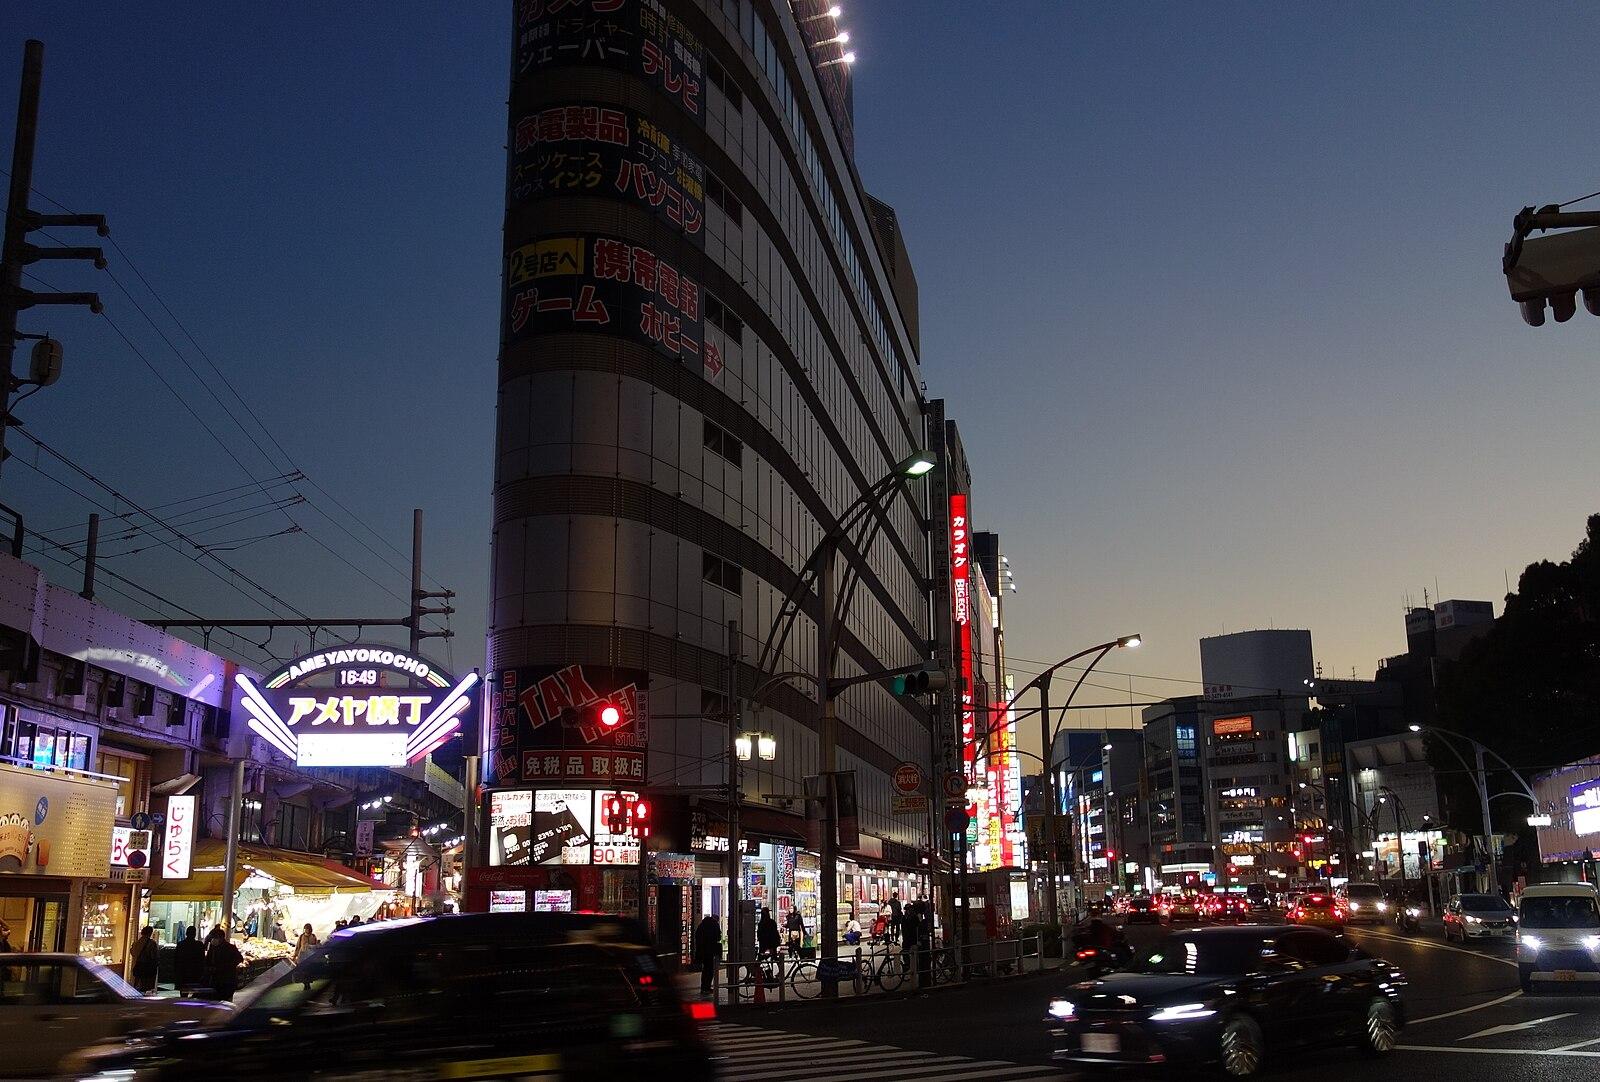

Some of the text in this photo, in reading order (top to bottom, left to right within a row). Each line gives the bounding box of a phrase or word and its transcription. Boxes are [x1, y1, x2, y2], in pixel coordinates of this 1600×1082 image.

[555, 17, 633, 36] ドライヤー
[519, 37, 629, 73] シェーバー
[642, 38, 699, 115] テレビ
[516, 106, 629, 153] 家電製品
[638, 140, 676, 175] エアコン
[548, 171, 602, 189] インク
[615, 158, 703, 233] パソコン
[512, 251, 577, 280] 2号店へ
[594, 239, 698, 322] 携帯電話
[511, 286, 610, 333] ゲーム
[640, 301, 698, 354] ホビー
[953, 516, 966, 567] カラオケ
[956, 579, 966, 598] BIG
[289, 649, 429, 680] AMEYAYOKOCHO
[340, 670, 376, 685] 16:49
[287, 695, 432, 726] アメヤ横丁
[519, 664, 599, 730] TAX
[526, 757, 642, 777] 免税品取扱店
[167, 806, 184, 874] じゅらく
[566, 834, 588, 848] VISA
